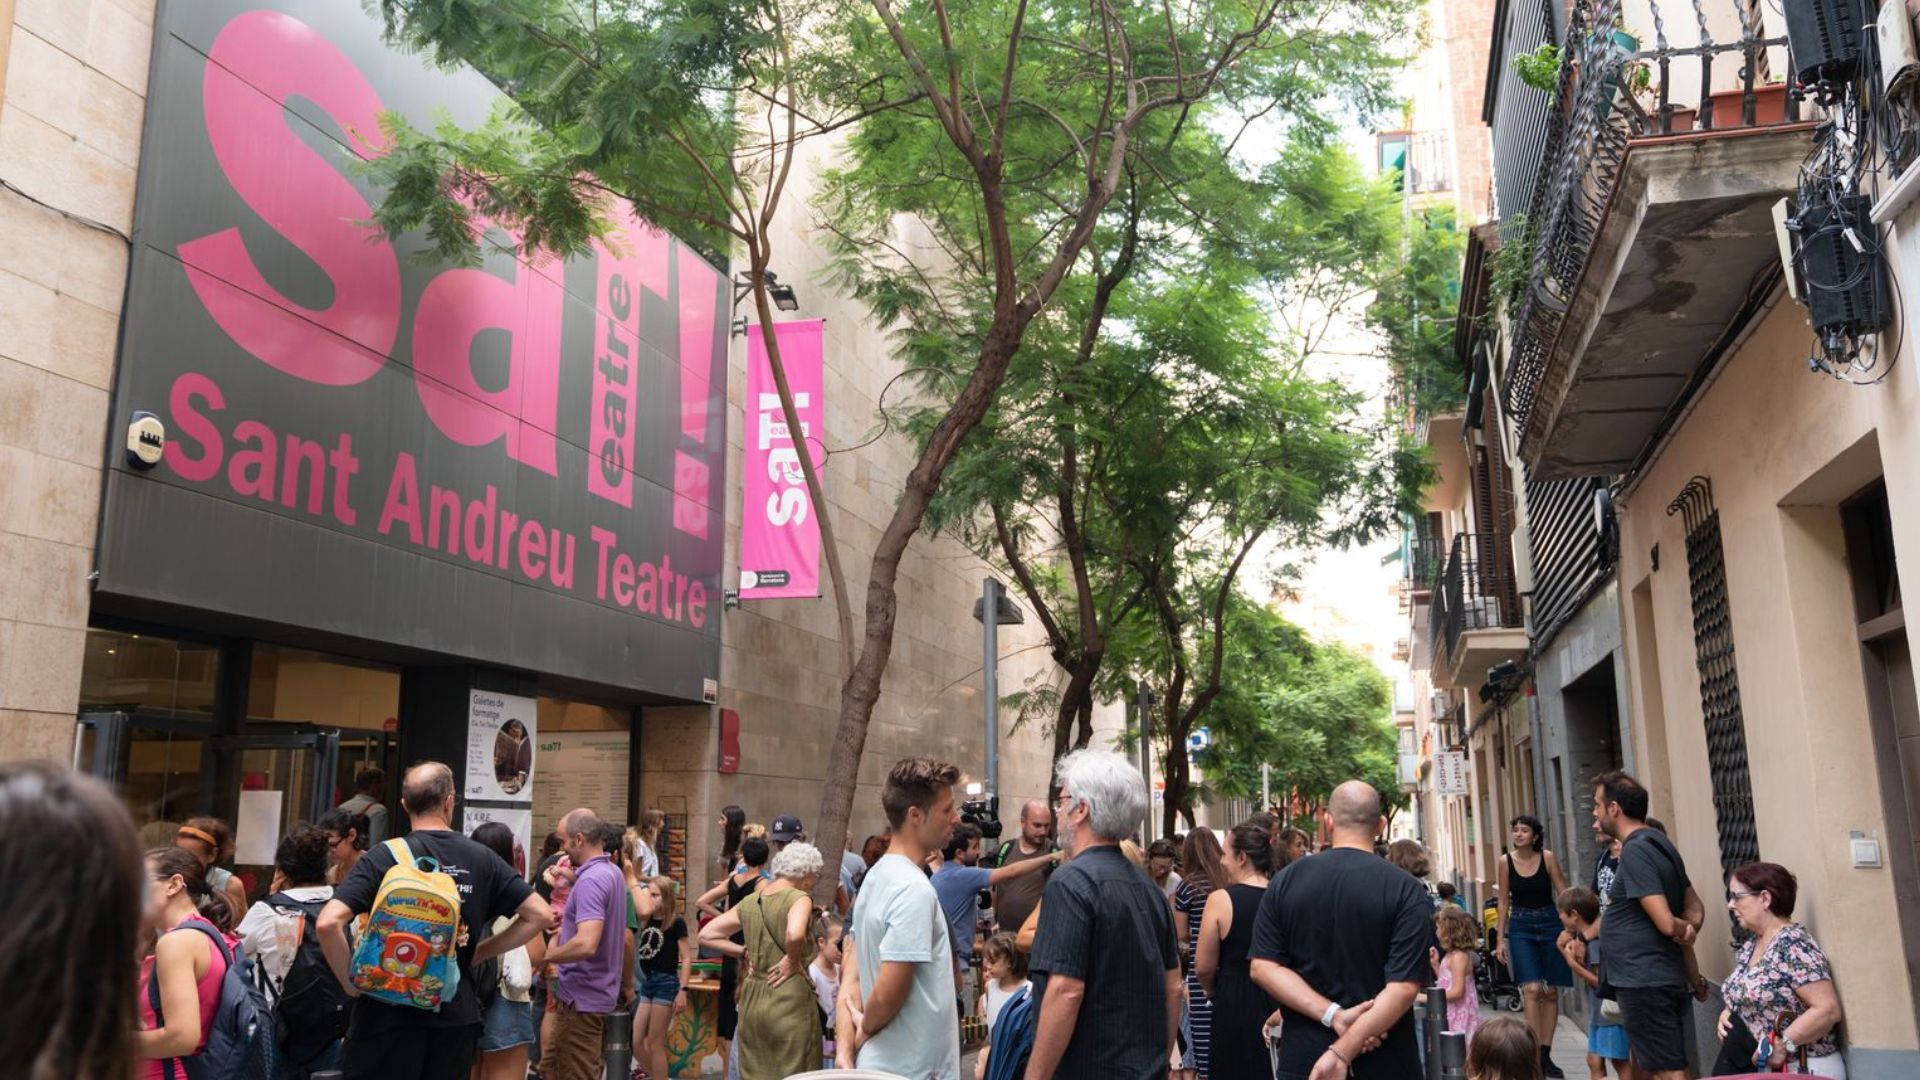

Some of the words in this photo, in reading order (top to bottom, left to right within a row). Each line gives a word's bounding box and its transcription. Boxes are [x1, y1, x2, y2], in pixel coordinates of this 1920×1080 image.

[599, 270, 633, 490] eatre
[162, 371, 359, 527] Sant
[378, 451, 577, 591] Andreu
[591, 525, 709, 629] Teatre
